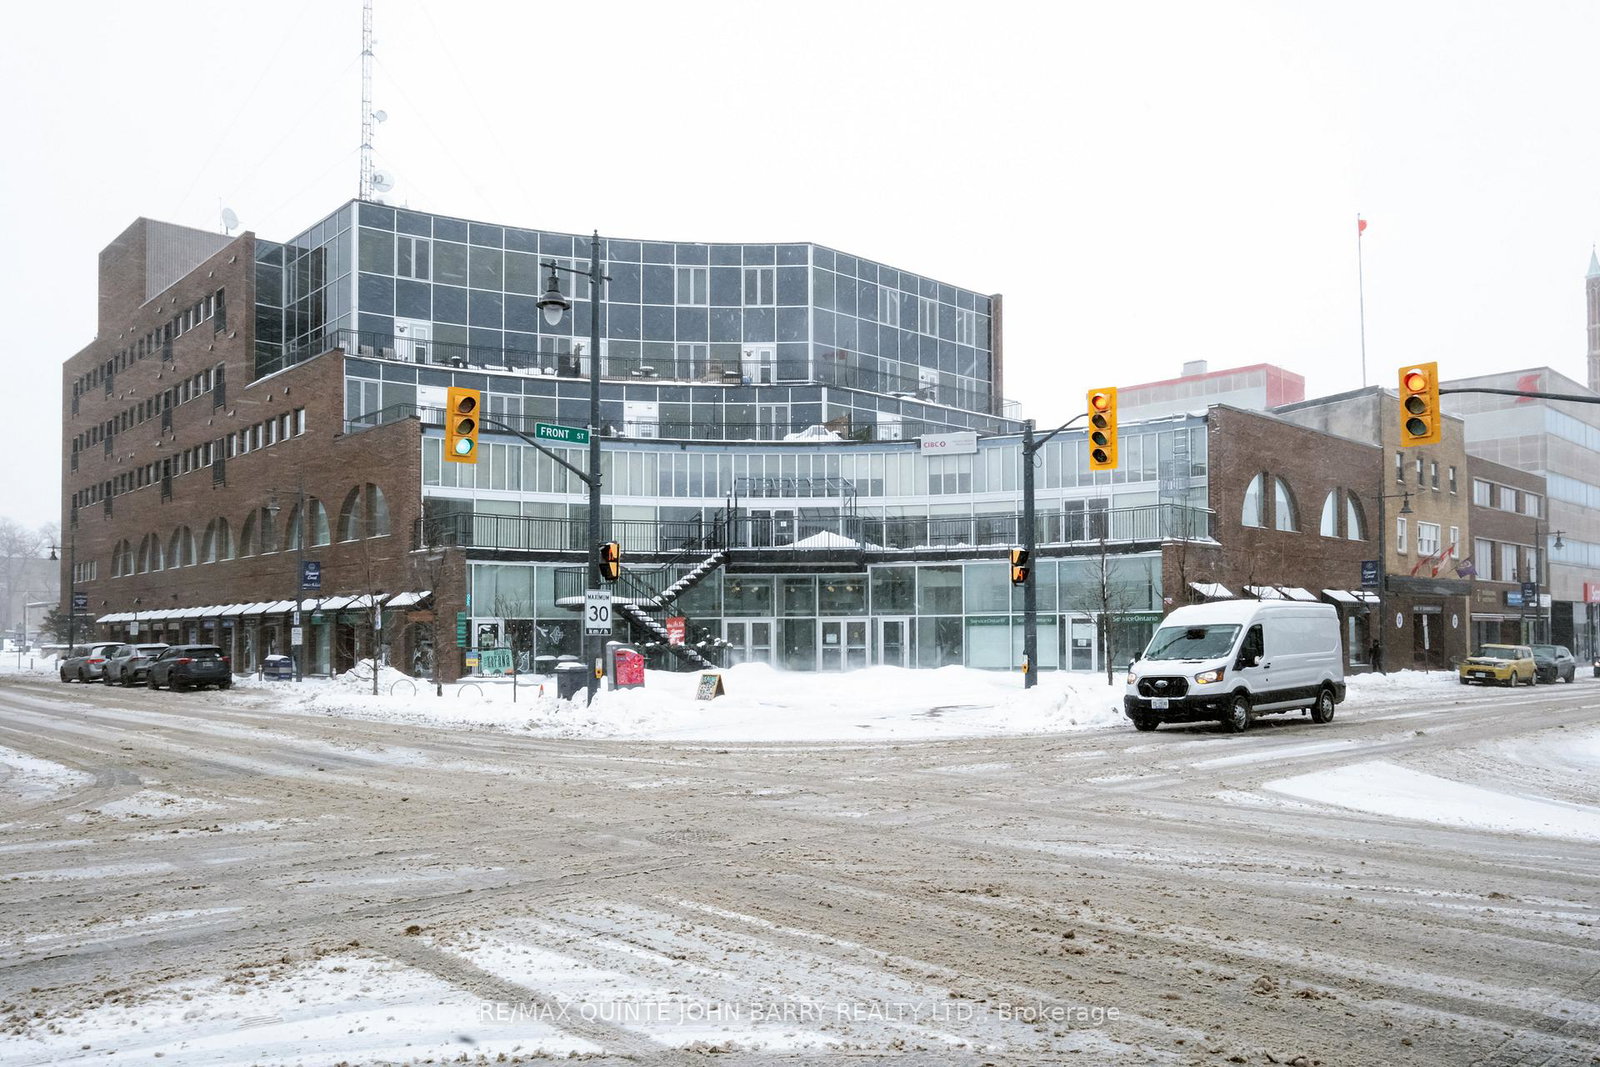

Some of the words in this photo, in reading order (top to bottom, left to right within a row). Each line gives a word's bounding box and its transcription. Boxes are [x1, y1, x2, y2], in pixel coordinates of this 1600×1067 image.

[540, 426, 570, 439] FRONT
[576, 432, 585, 440] ST
[589, 605, 609, 622] 30
